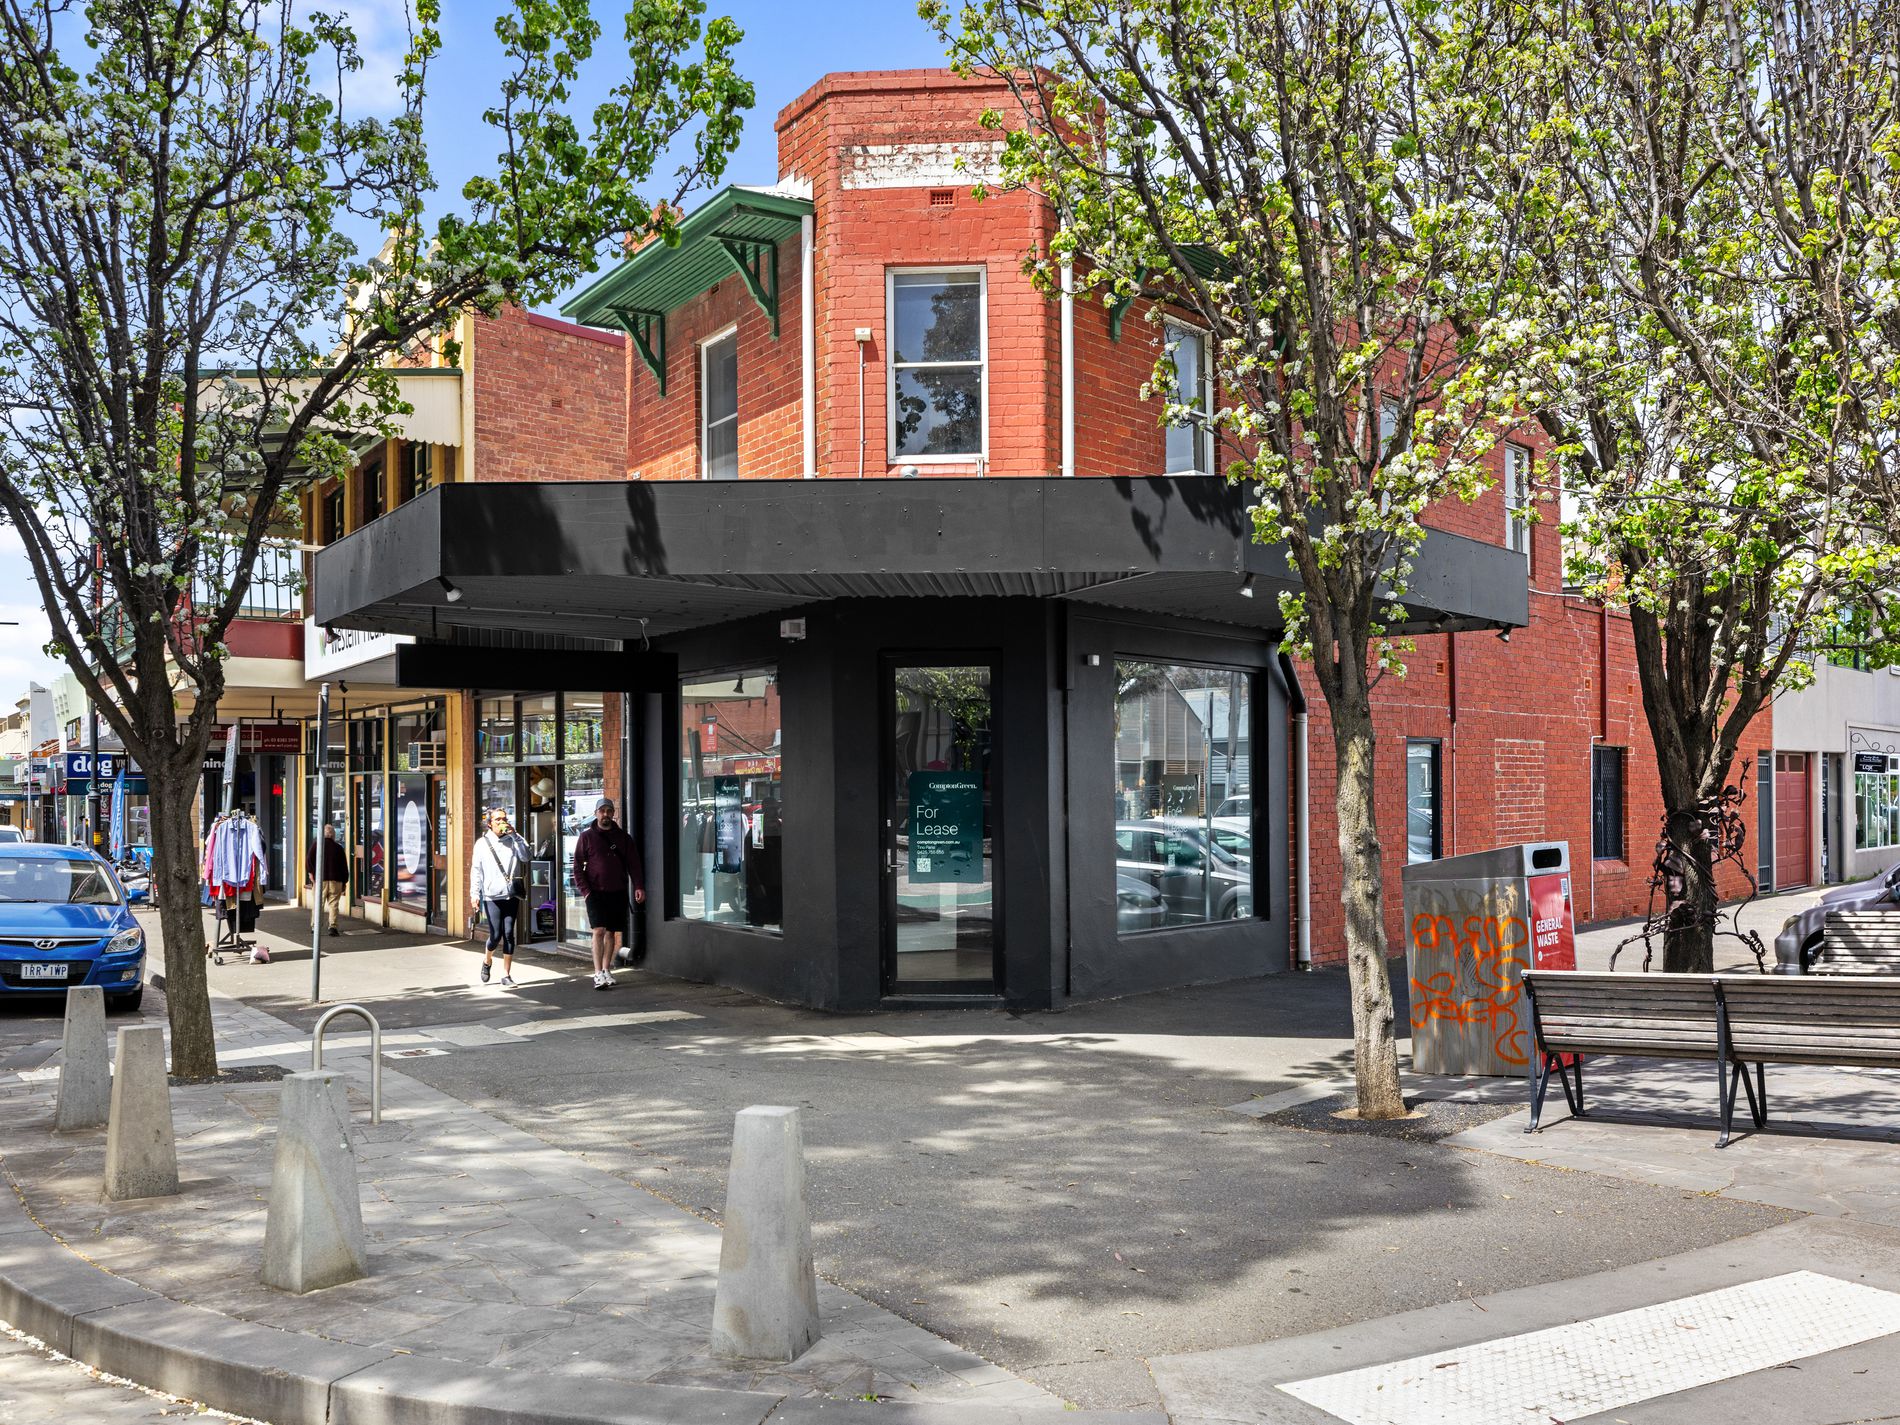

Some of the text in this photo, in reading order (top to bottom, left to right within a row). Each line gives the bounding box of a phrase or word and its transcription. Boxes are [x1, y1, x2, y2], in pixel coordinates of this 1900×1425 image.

[916, 805, 939, 819] For
[916, 821, 959, 836] Lease
[1536, 917, 1563, 933] GENERAL
[1537, 932, 1559, 948] WASTE
